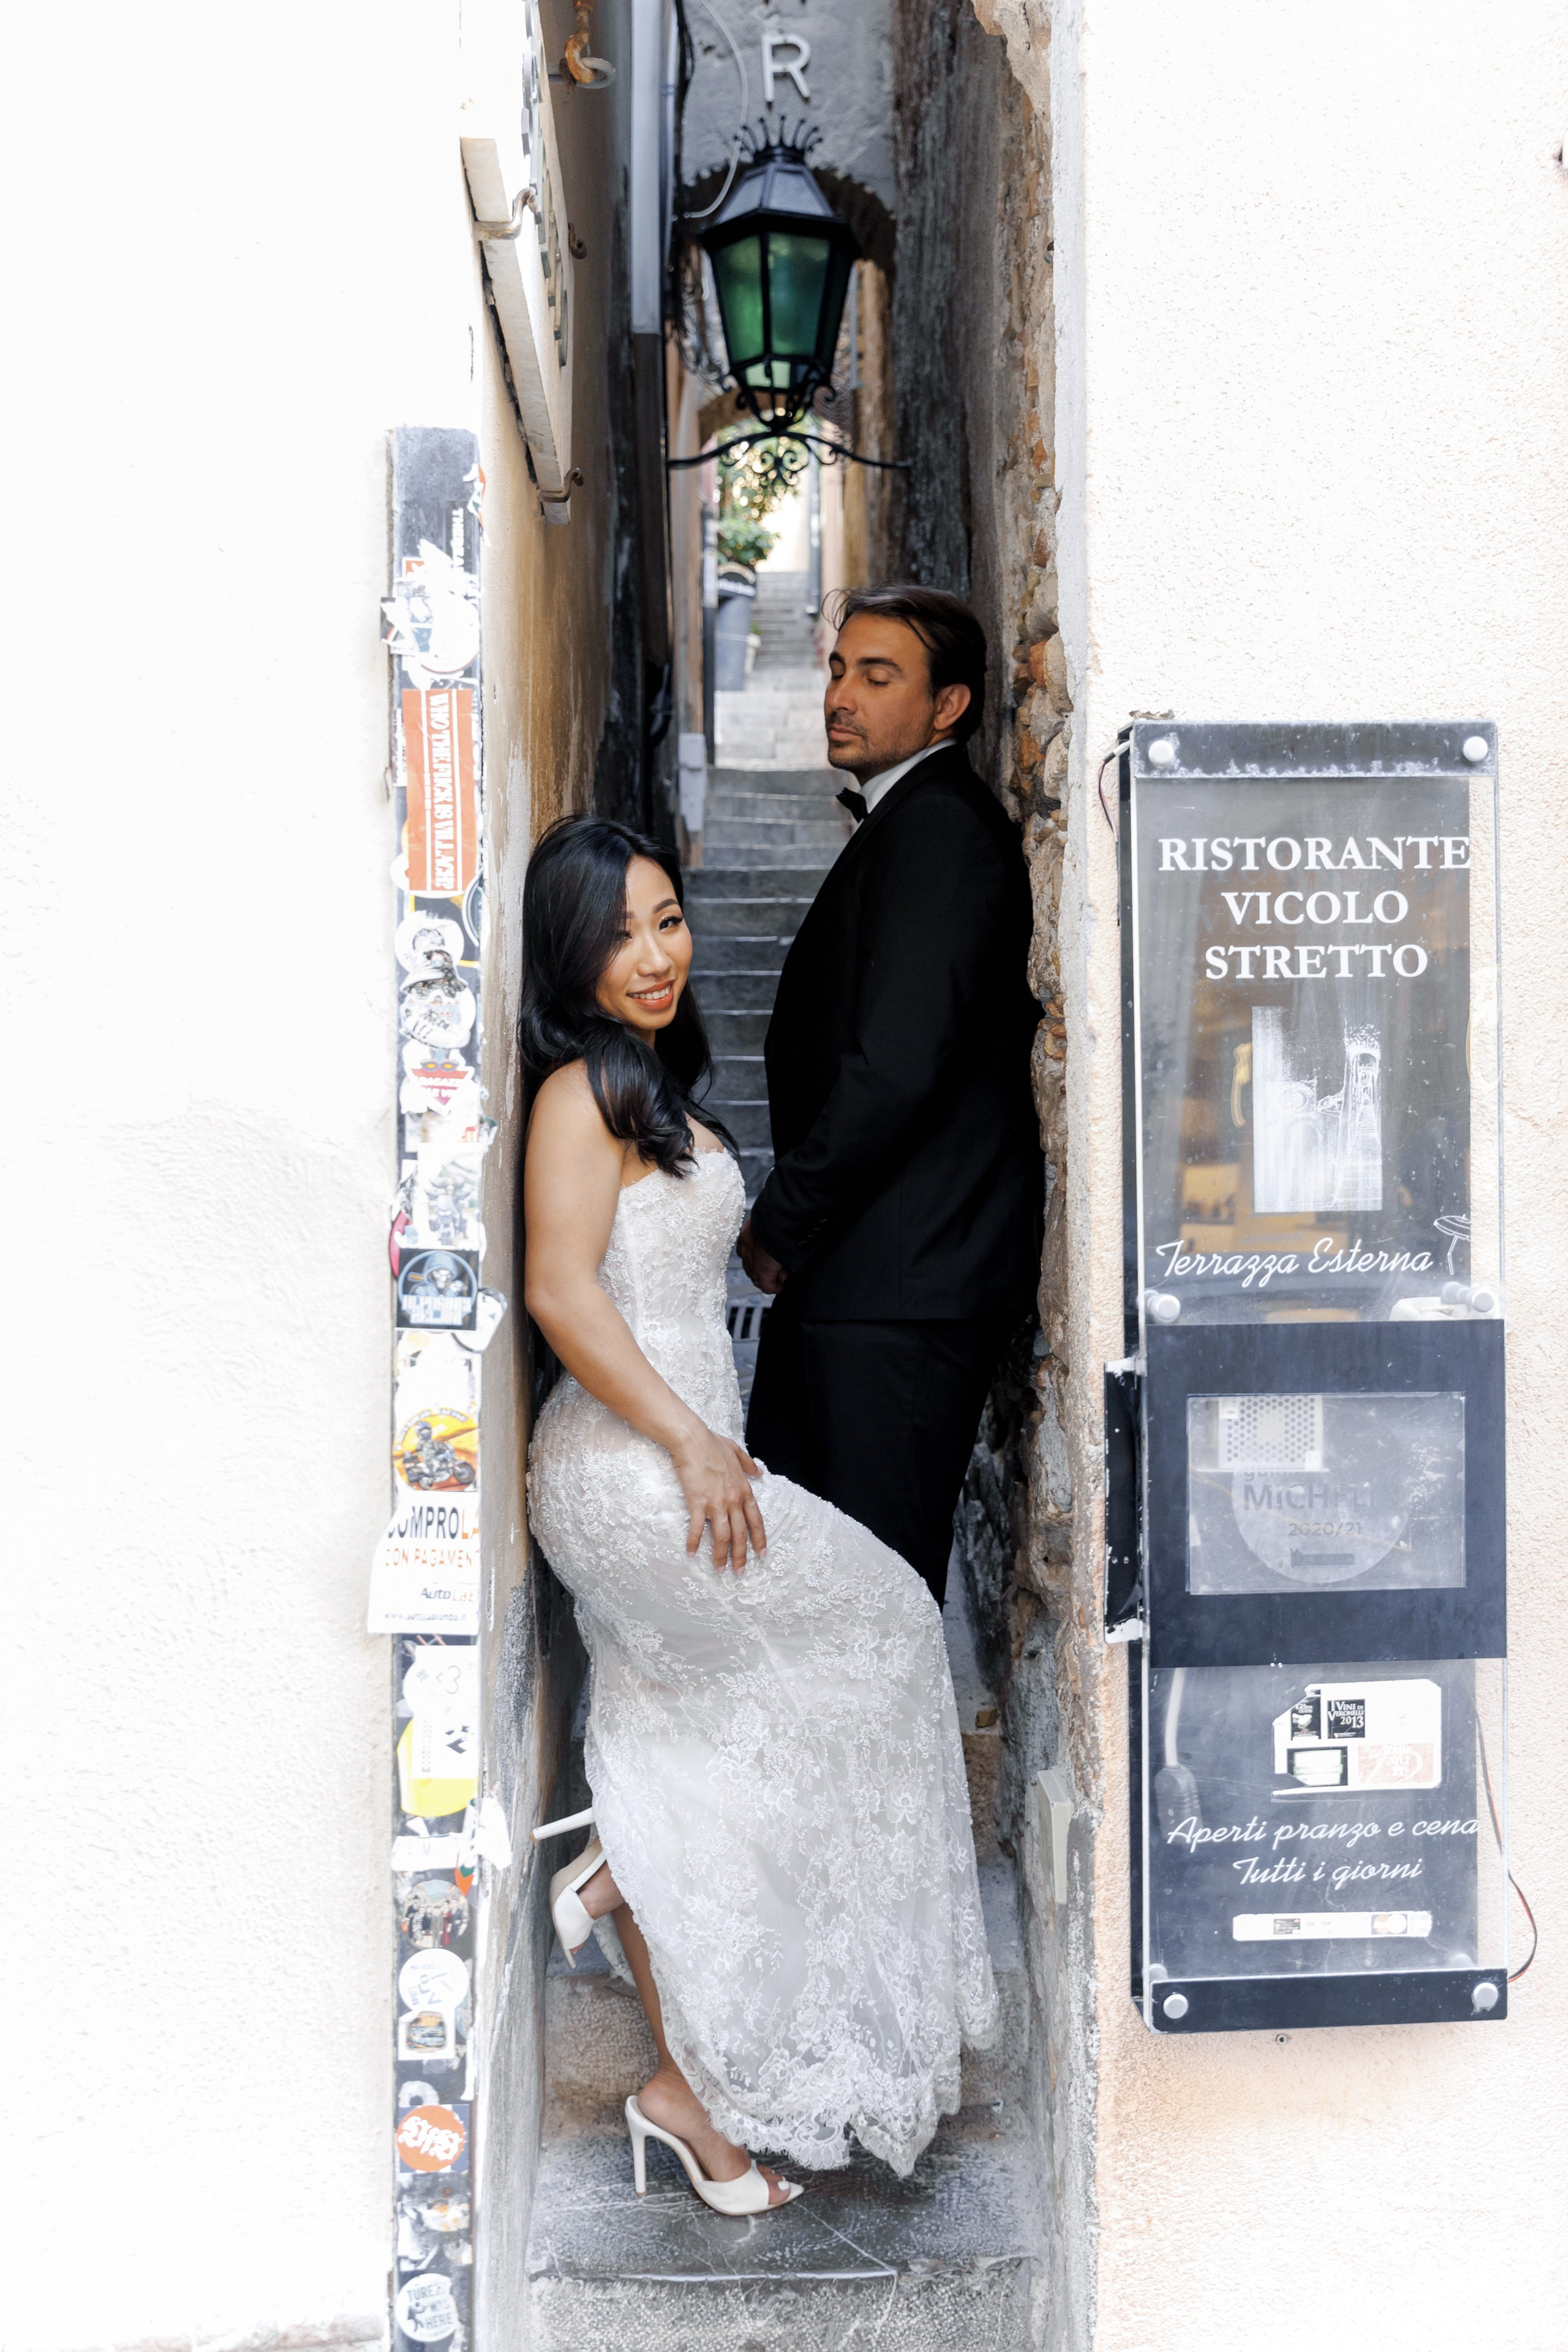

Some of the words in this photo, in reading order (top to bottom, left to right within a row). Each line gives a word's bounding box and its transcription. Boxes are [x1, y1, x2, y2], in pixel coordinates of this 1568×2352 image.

[761, 33, 811, 103] R
[429, 693, 450, 731] WHO
[431, 731, 451, 764] THE
[1158, 835, 1471, 872] RISTORANTE
[1221, 890, 1409, 924] VICOLO
[1205, 944, 1428, 979] STRETTO
[1156, 1240, 1299, 1287] Terrazza
[1308, 1237, 1433, 1273] Esterna
[1287, 1521, 1361, 1537] 2020/21
[1340, 1716, 1364, 1728] 2013
[1167, 1815, 1267, 1853] Aperti
[1273, 1822, 1382, 1850] pranzo
[1388, 1820, 1404, 1837] e
[1412, 1817, 1479, 1836] cena
[1232, 1856, 1306, 1885] Tutti
[1312, 1860, 1325, 1883] i
[1333, 1858, 1423, 1890] giorni
[424, 2312, 454, 2330] HERE
